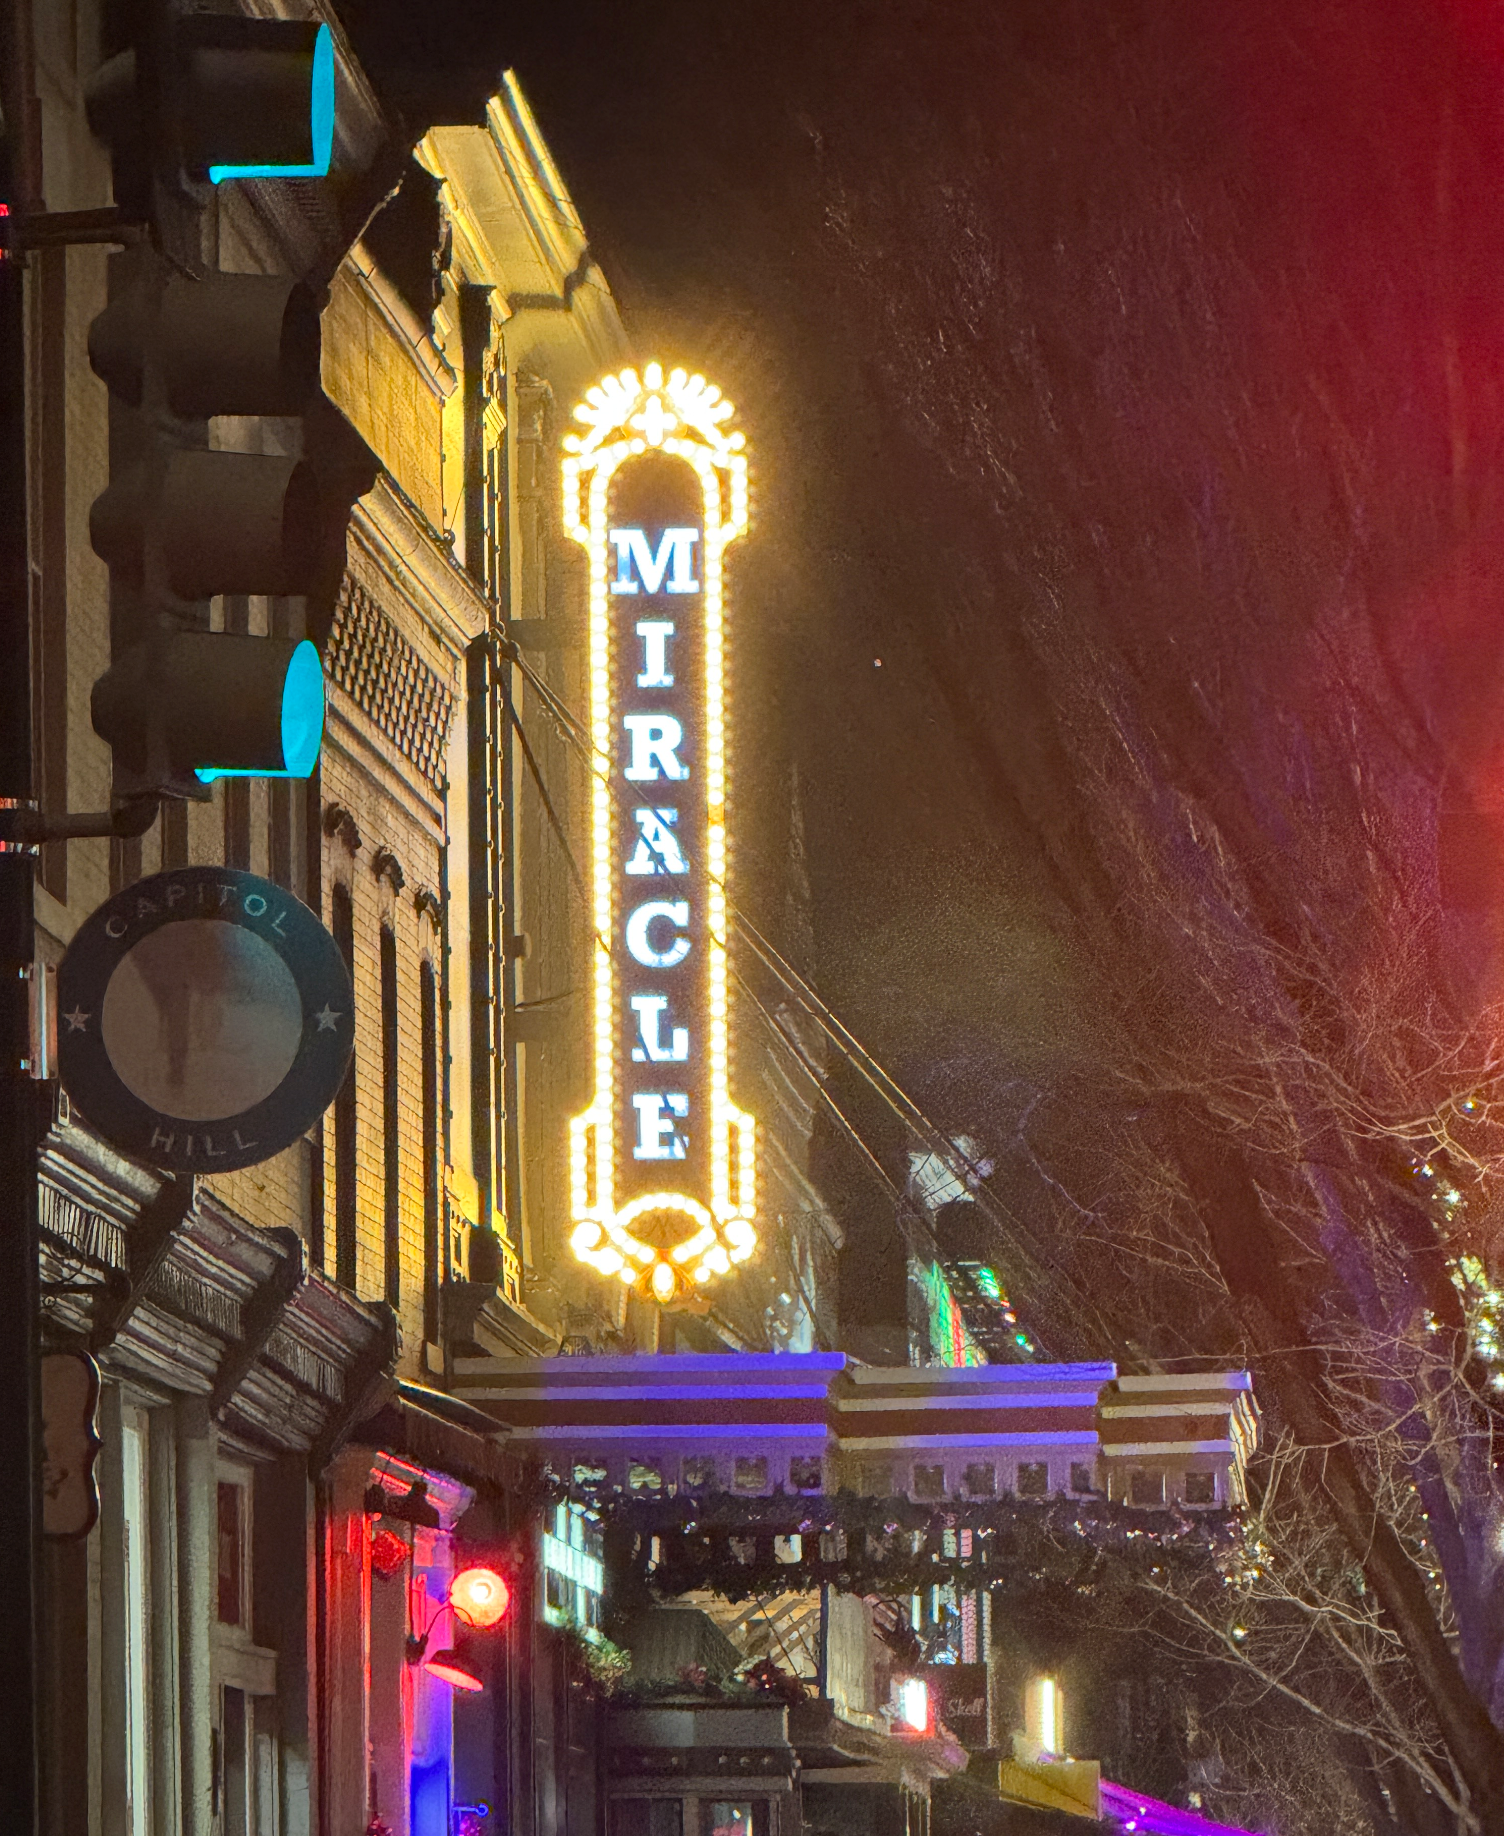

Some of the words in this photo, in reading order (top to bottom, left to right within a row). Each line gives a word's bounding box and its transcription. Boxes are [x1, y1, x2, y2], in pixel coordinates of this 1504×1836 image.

[609, 527, 699, 1160] MIRACLE
[106, 883, 287, 938] CAPITOL
[151, 1127, 258, 1156] HILL
